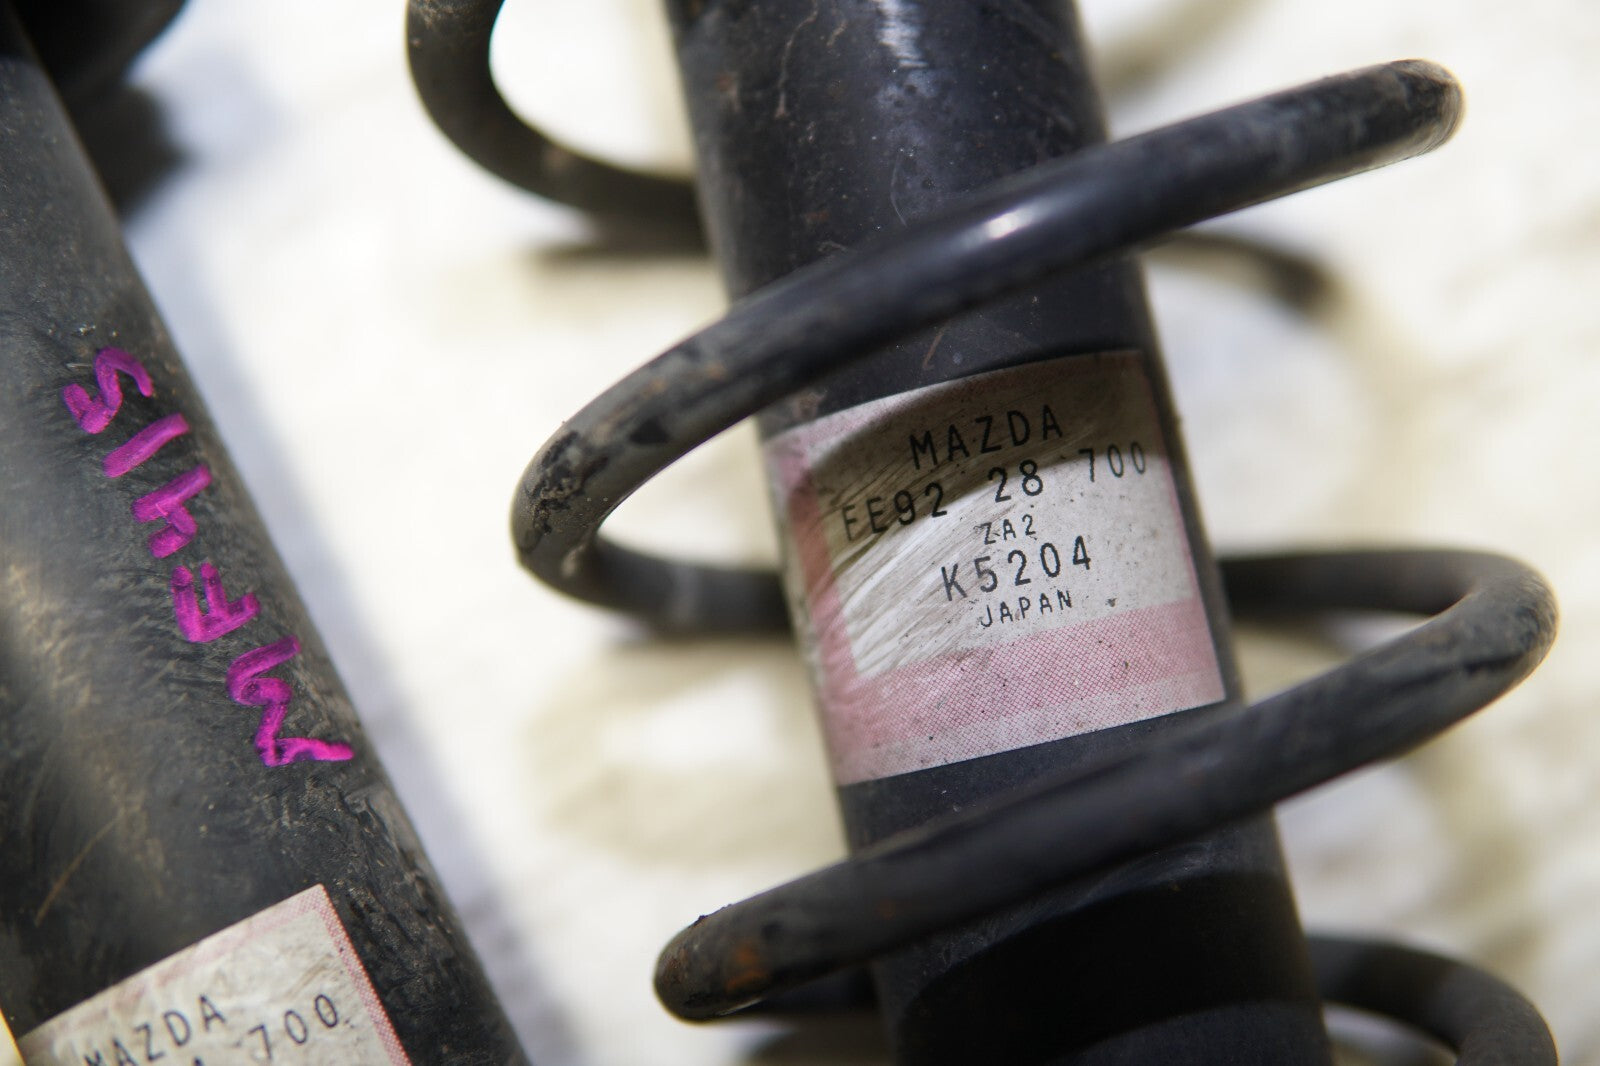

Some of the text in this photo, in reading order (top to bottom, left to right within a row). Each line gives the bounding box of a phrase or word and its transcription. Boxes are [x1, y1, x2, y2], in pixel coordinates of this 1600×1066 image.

[909, 405, 1063, 470] MAZDA
[842, 441, 1147, 540] FE92 28 700
[979, 514, 1037, 545] ZA2
[941, 535, 1093, 602] K5204
[979, 590, 1072, 628] JAPAN
[248, 994, 338, 1060] 700
